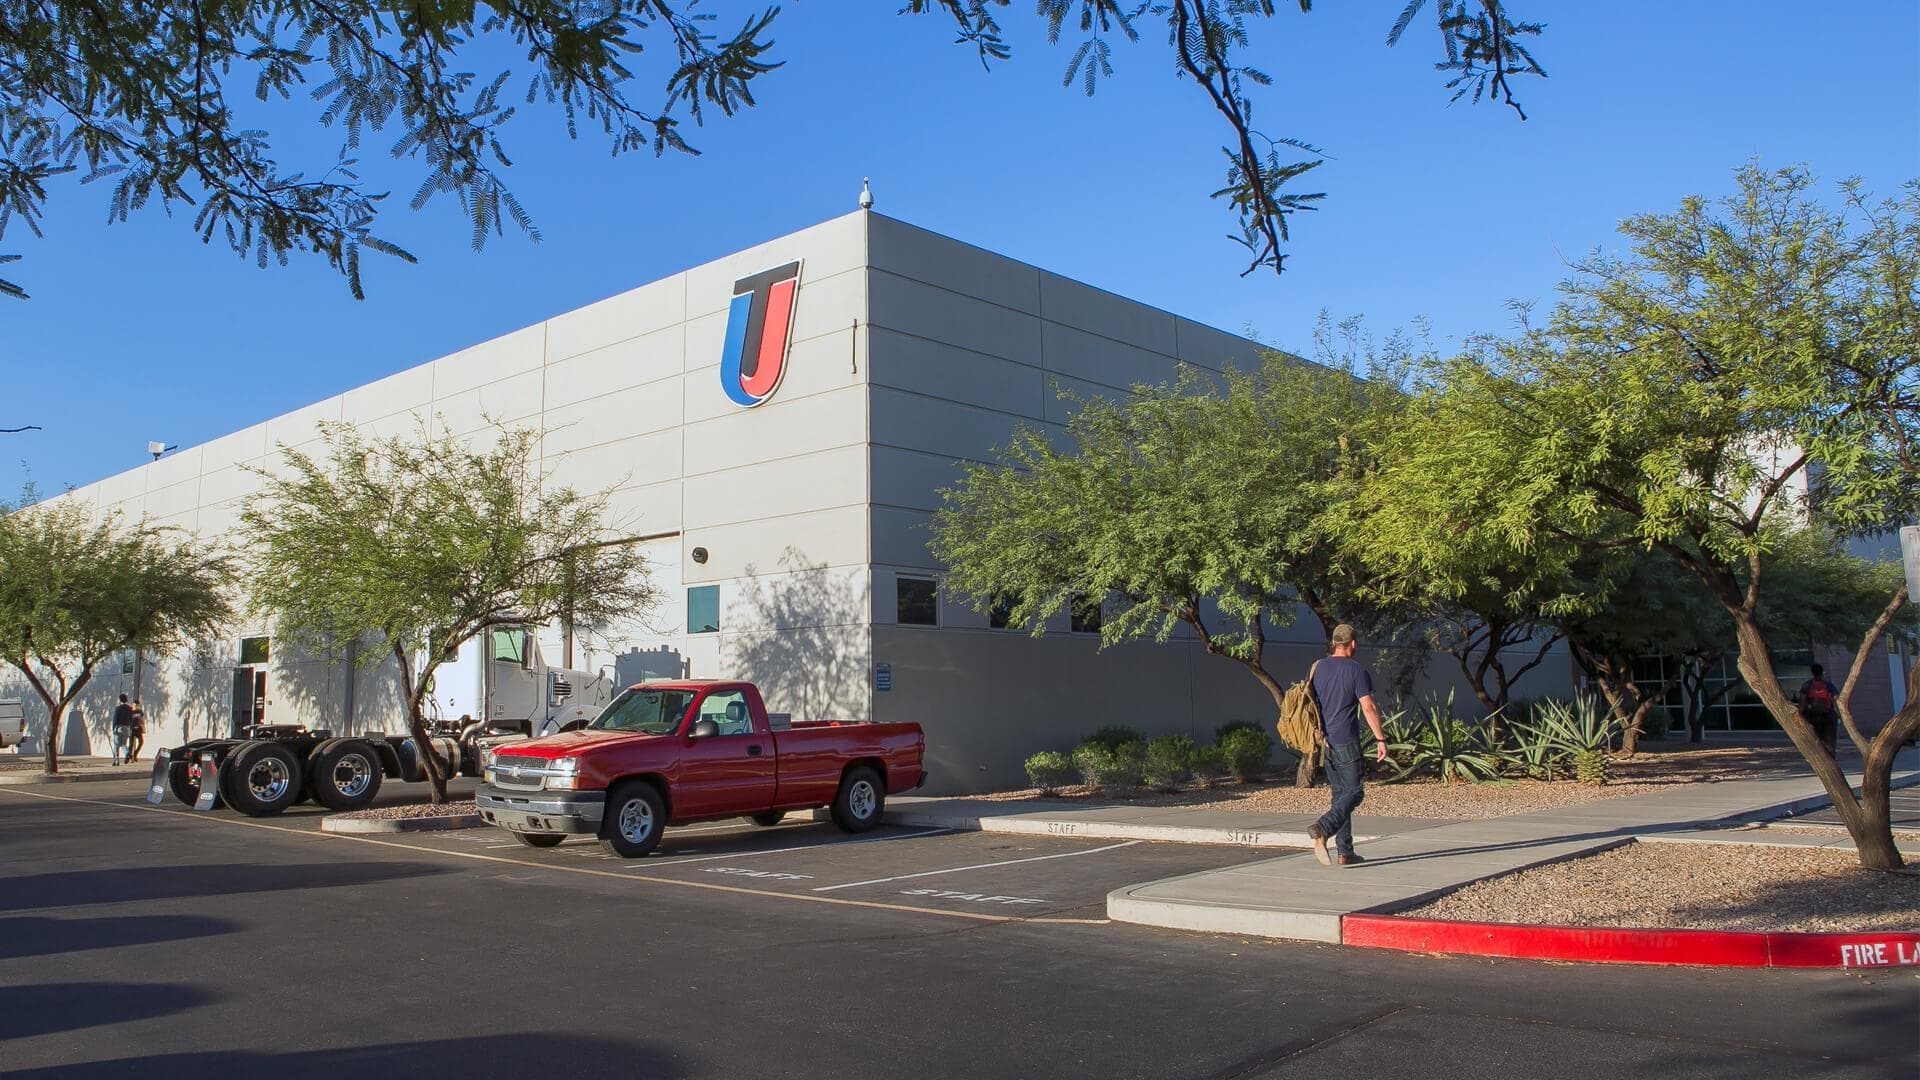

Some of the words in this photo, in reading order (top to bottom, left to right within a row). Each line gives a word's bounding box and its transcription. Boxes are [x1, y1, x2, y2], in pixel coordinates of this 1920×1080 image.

[1048, 823, 1076, 834] STAFF
[1227, 831, 1261, 844] STAFF
[698, 867, 815, 880] STAFF
[899, 889, 1054, 904] STAFF
[1841, 943, 1888, 966] FIRE
